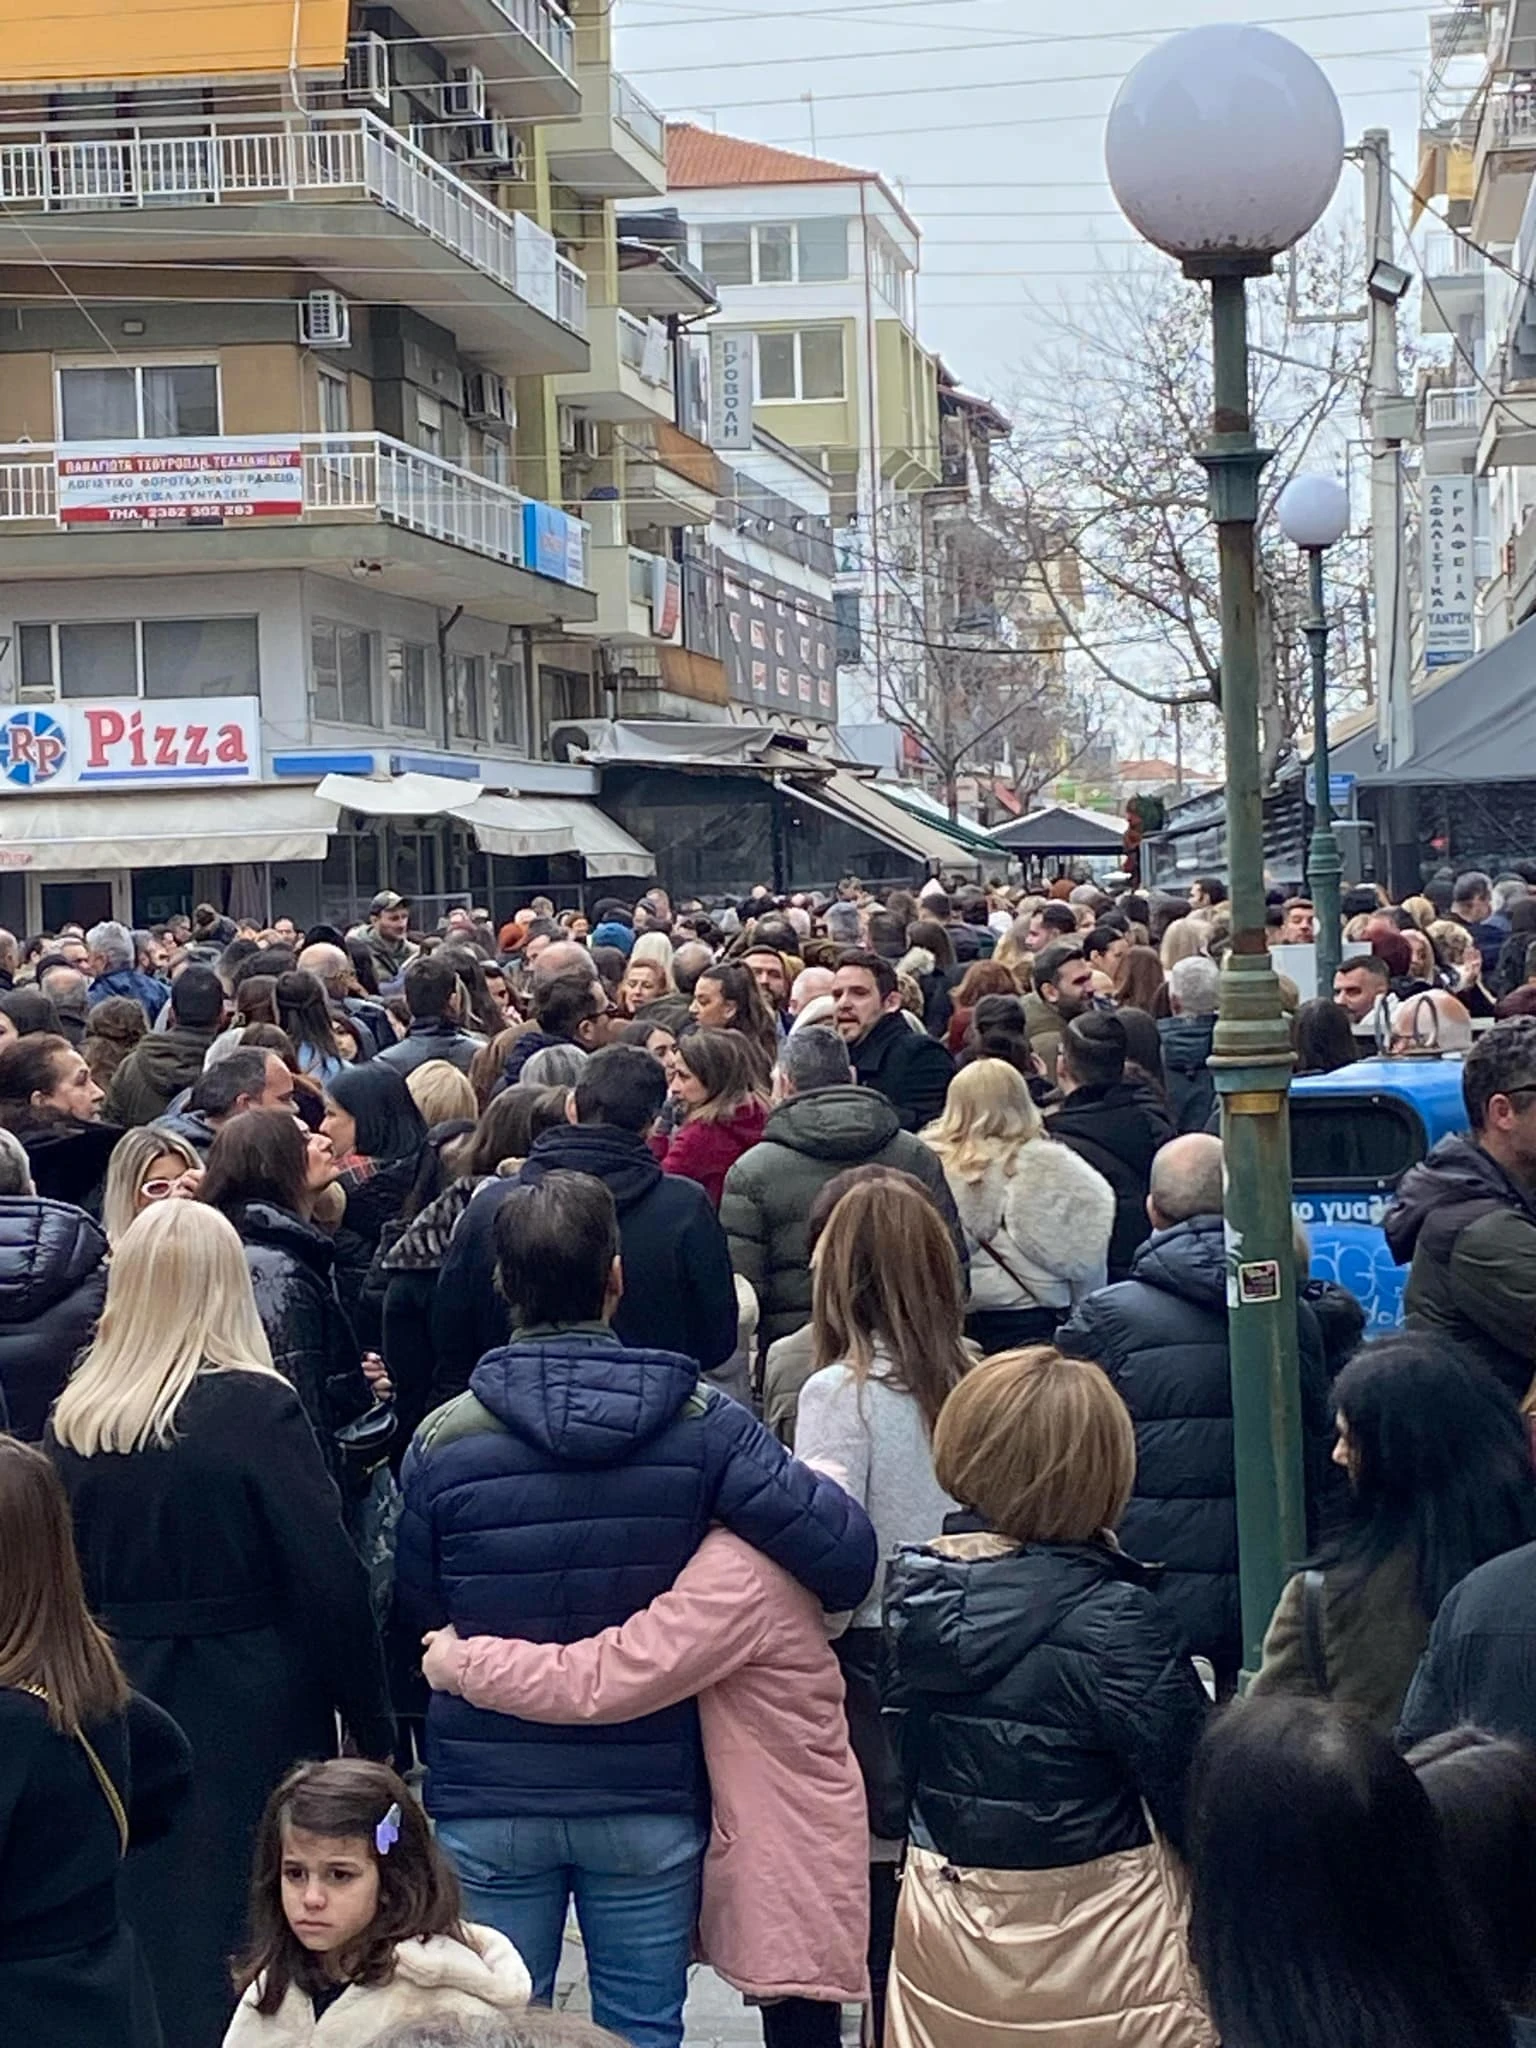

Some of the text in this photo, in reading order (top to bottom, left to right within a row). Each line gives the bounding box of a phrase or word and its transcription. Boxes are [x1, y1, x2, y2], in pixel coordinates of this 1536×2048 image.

[723, 340, 739, 438] ΠΡΟΒΟΛΗ
[1450, 489, 1467, 600] ΓΡΑΦΕΙΑ
[84, 708, 248, 768] Pizza
